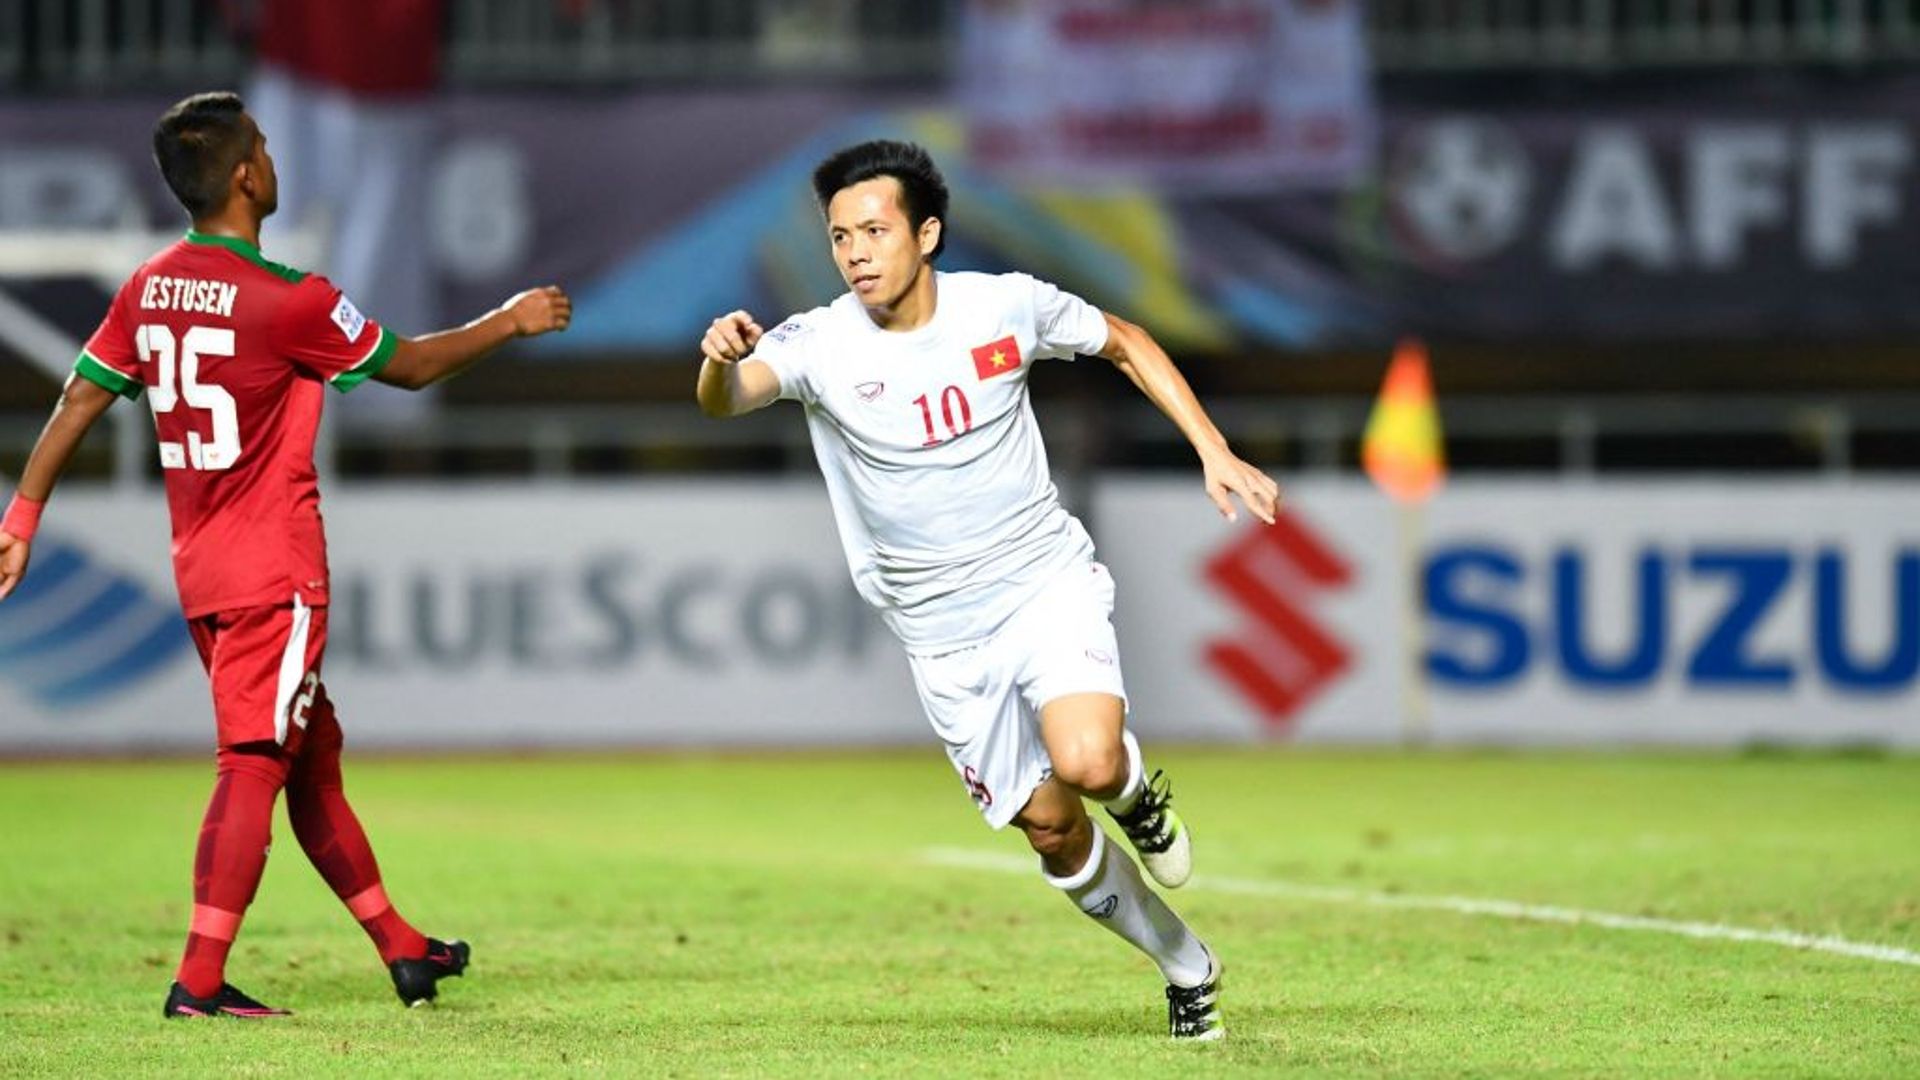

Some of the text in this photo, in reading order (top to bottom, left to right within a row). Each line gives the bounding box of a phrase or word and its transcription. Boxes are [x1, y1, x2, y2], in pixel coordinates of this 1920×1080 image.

[1551, 124, 1908, 269] AFF
[140, 275, 238, 317] LESTUSEN
[135, 323, 243, 471] 25
[912, 384, 972, 447] 10
